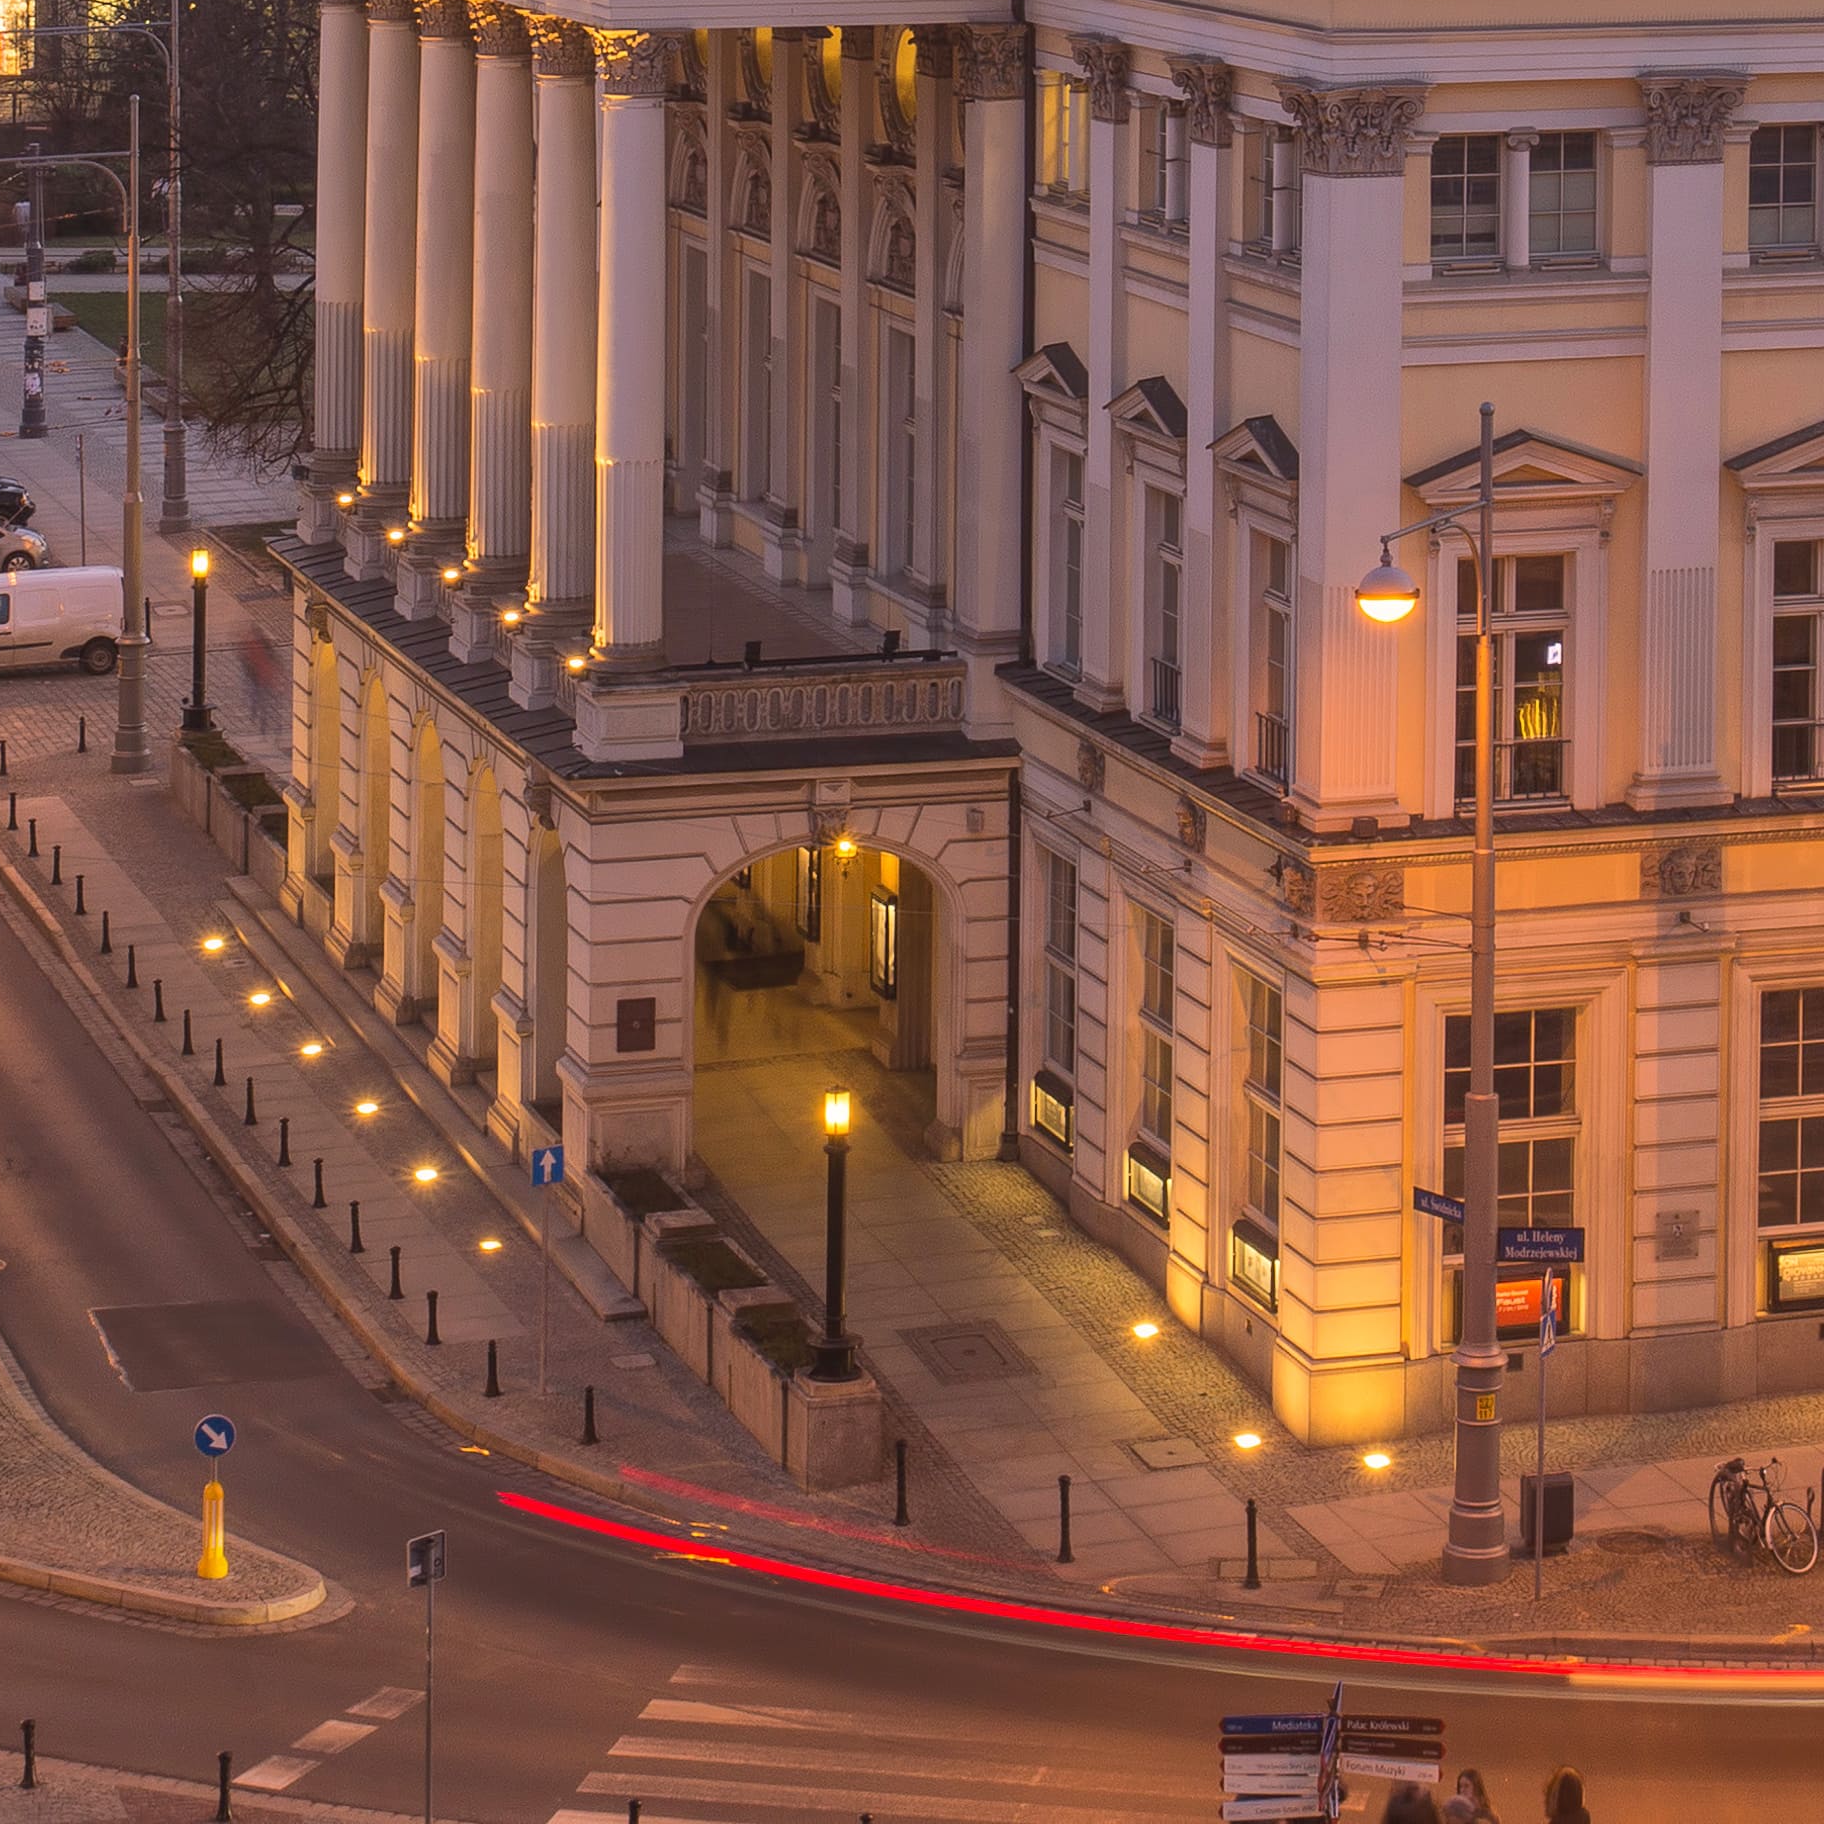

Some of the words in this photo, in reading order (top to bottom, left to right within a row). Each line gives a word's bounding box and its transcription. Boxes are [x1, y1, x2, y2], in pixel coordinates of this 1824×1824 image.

[1517, 1231, 1530, 1243] ul.
[1532, 1231, 1565, 1244] Heleny
[1505, 1246, 1578, 1260] Modrzejewskiej
[1272, 1720, 1318, 1731] Mediateka
[1346, 1759, 1373, 1772] Forum
